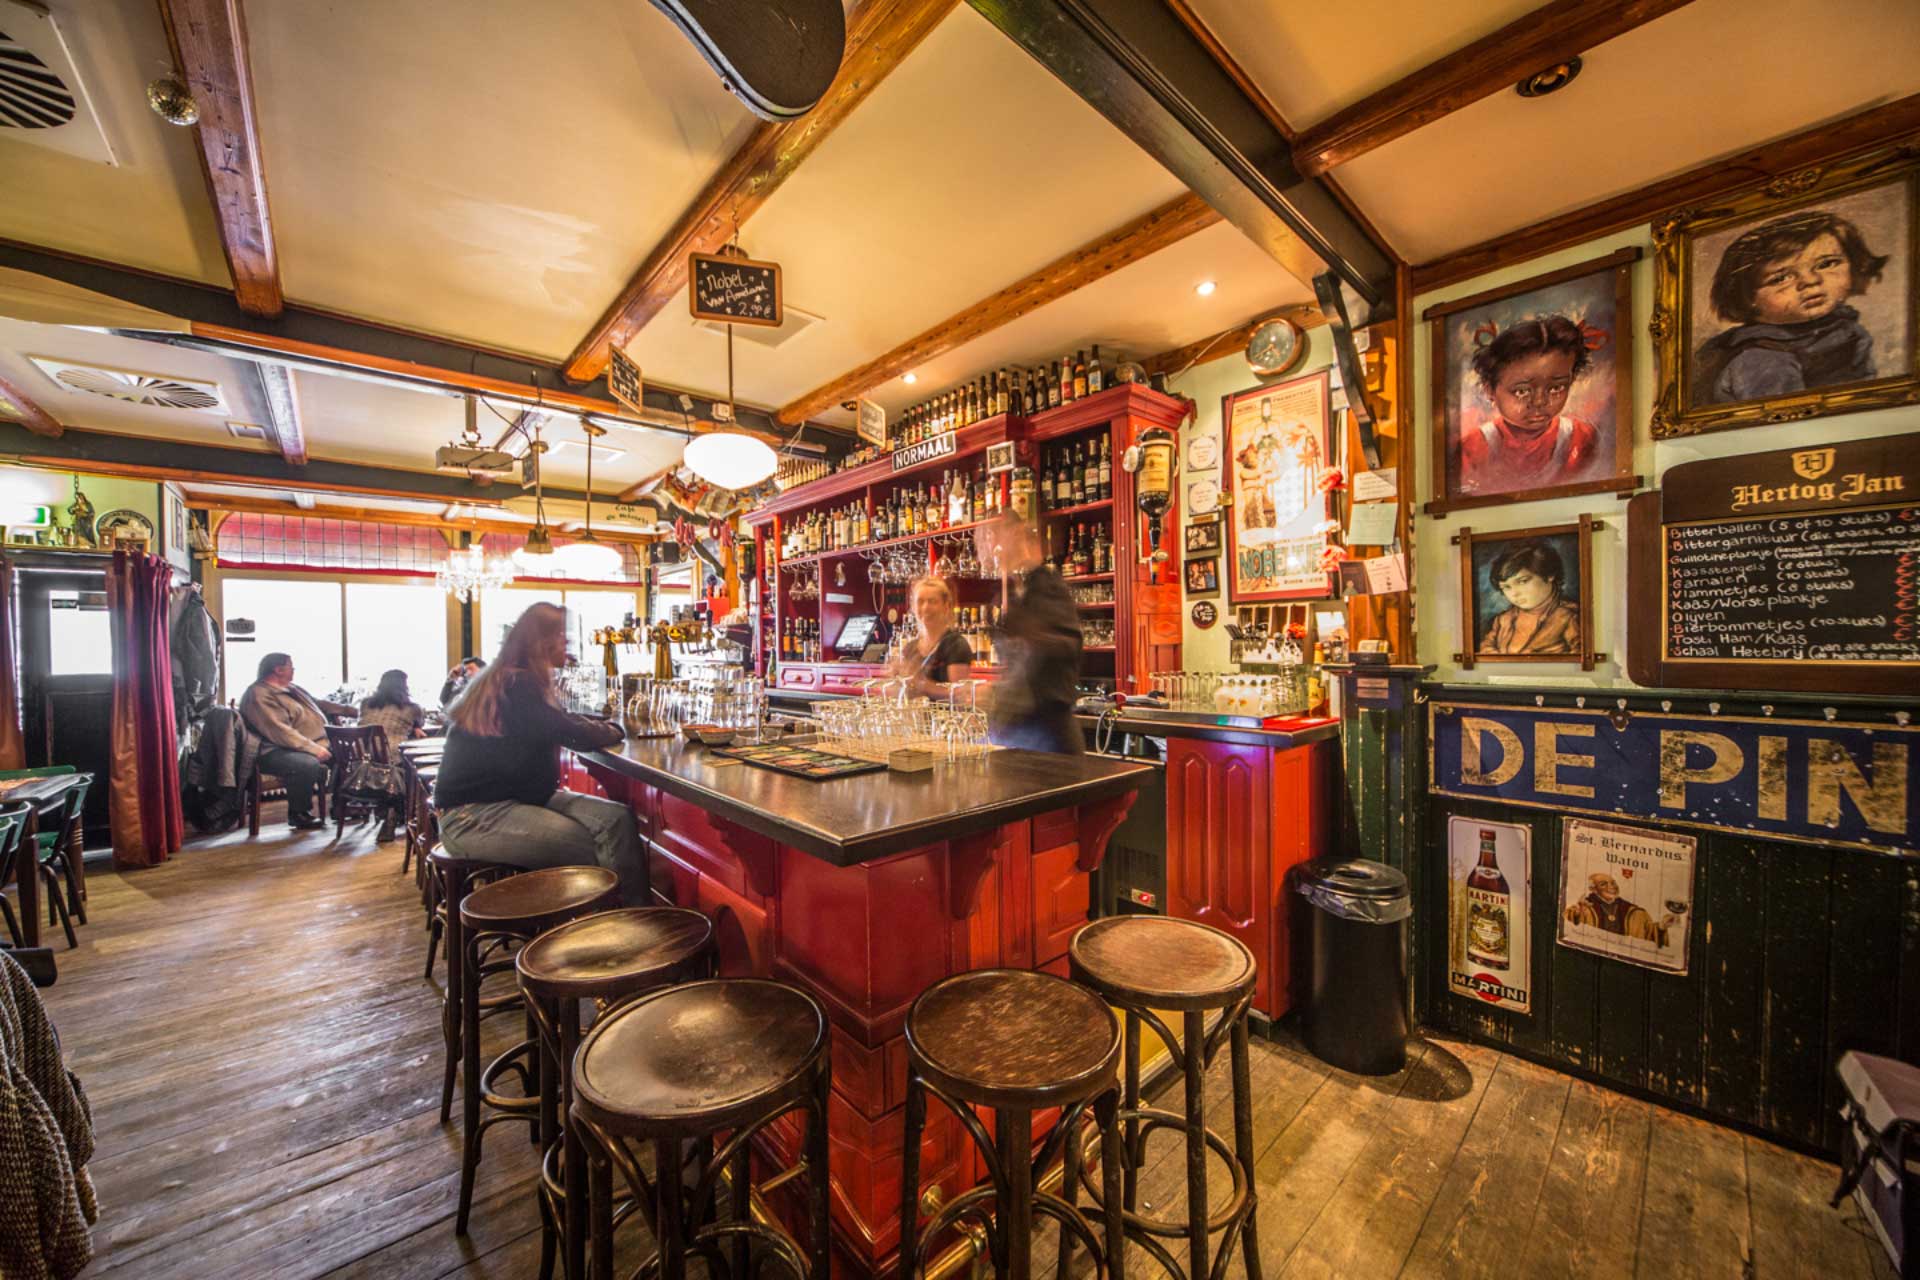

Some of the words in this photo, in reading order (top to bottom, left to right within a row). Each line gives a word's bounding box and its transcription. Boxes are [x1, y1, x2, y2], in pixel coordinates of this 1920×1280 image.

[895, 436, 952, 470] NORMAAL
[1731, 482, 1836, 511] Hertog
[1839, 473, 1905, 501] Jan
[1671, 523, 1762, 539] Bitterballen
[1673, 620, 1806, 634] Bierbommetjes
[1461, 717, 1595, 798] DE
[1659, 728, 1909, 835] PIN
[1601, 836, 1683, 861] Bernardus
[1606, 851, 1650, 870] Watou
[1453, 973, 1526, 1003] MARTINI
